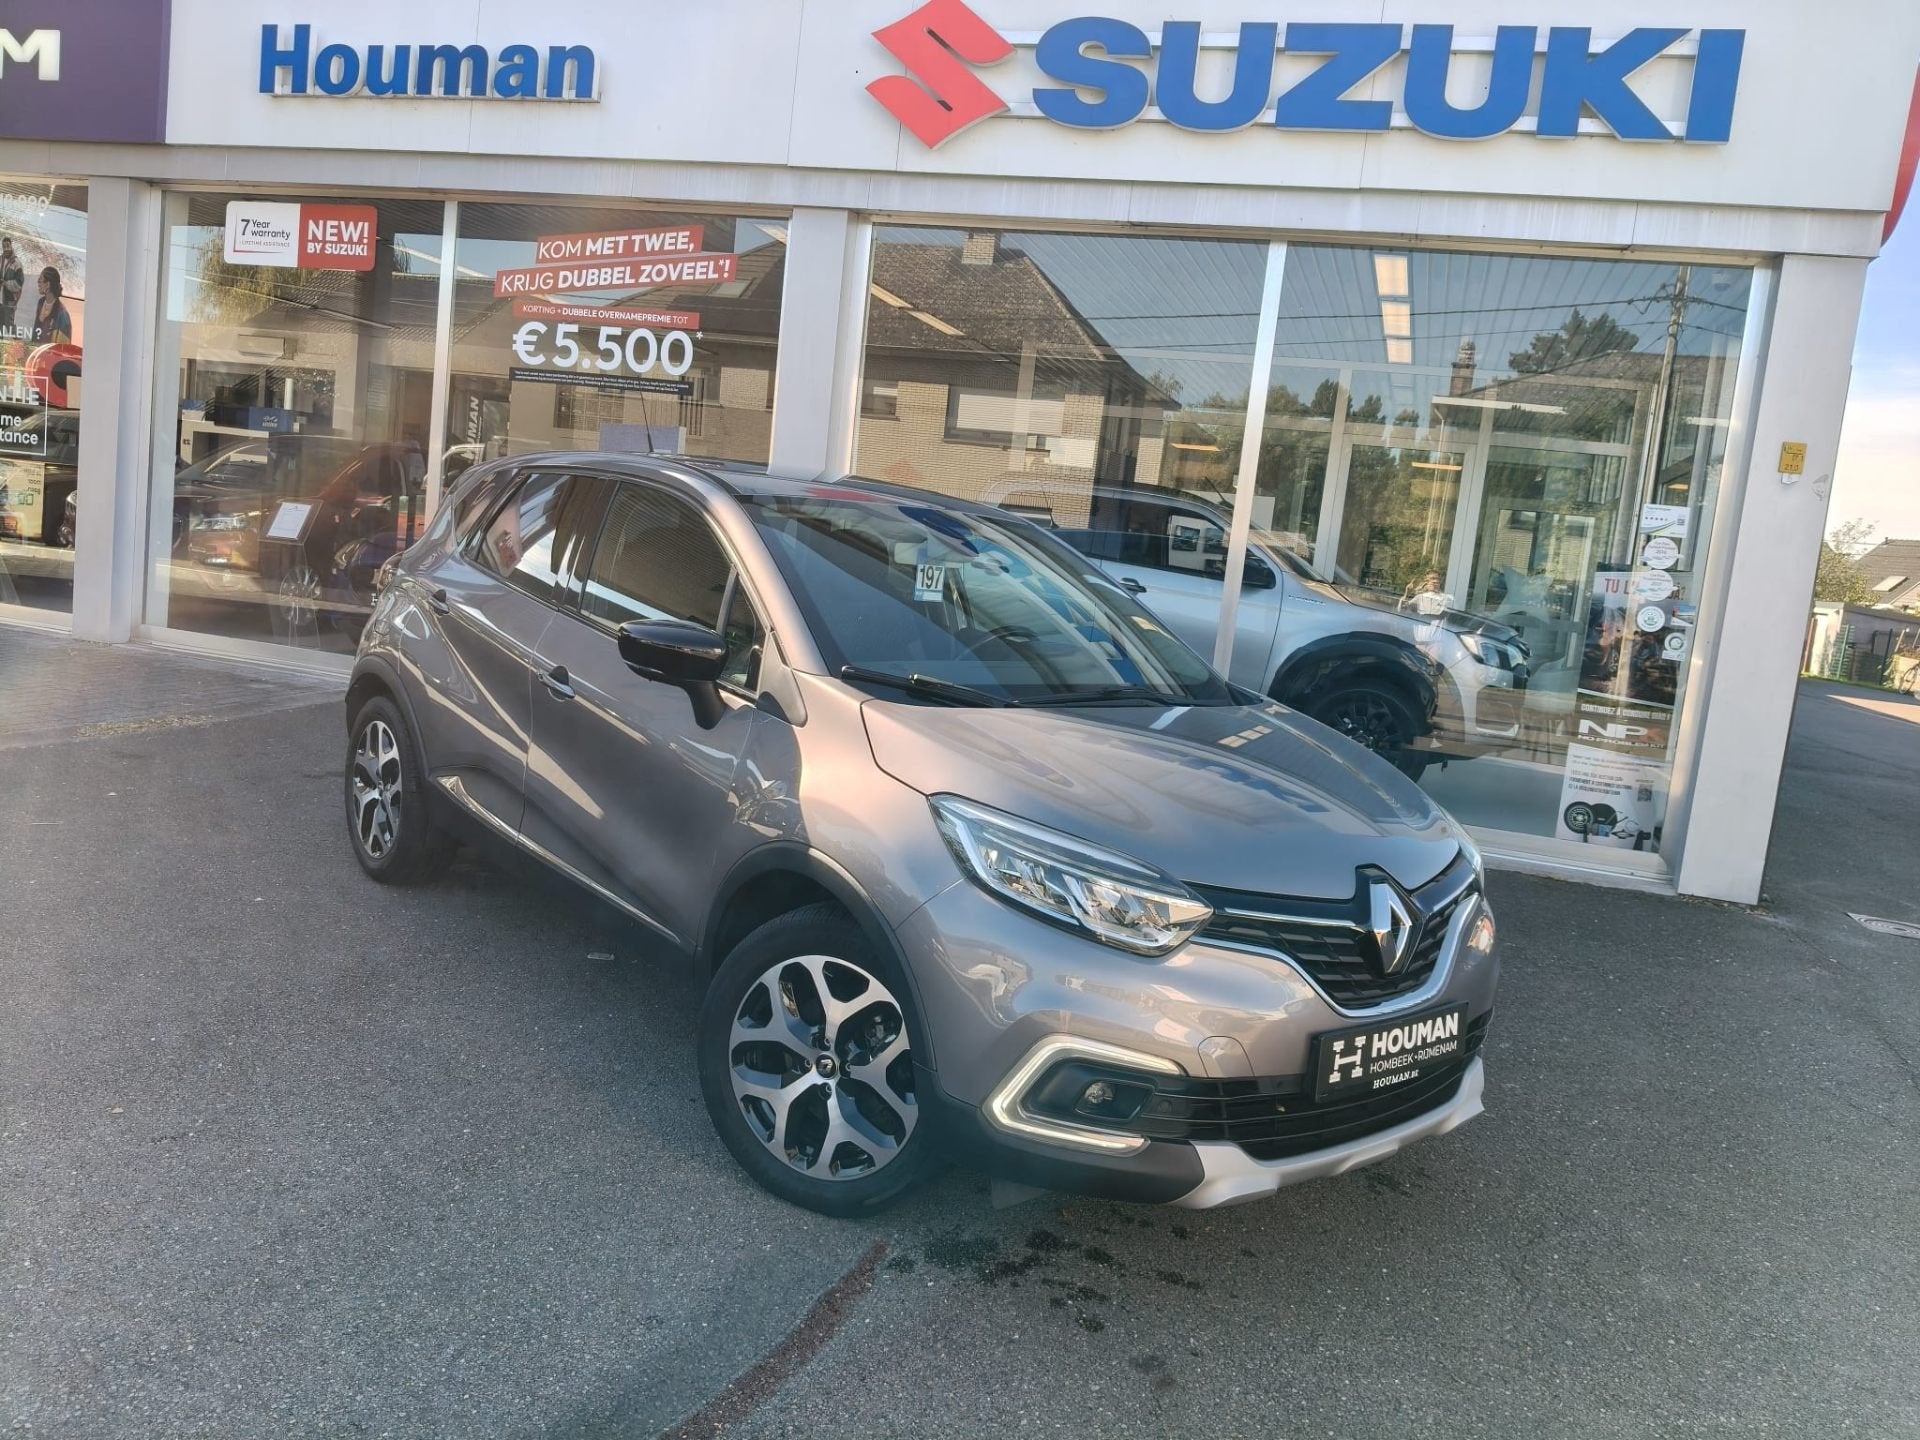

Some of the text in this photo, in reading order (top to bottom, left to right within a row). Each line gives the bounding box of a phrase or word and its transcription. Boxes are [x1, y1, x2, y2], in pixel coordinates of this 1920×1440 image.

[259, 23, 597, 98] Houman
[1033, 17, 1746, 144] SUZUKI
[240, 218, 271, 237] 7 Year
[251, 229, 291, 241] warranty
[307, 219, 370, 244] NEW!
[307, 242, 368, 256] BY SUZUKI
[538, 231, 695, 260] KOM MET TWEE,
[501, 272, 555, 293] KRIJG
[558, 265, 636, 289] DUBBEL
[522, 304, 557, 315] KORTING
[562, 308, 598, 318] DUBBELE
[598, 310, 672, 324] OVERNAMEPREMIE
[672, 315, 689, 325] TOT
[0, 324, 33, 339] LLEN
[919, 565, 943, 589] 197
[1371, 1012, 1459, 1058] HOUMAN
[1370, 1040, 1457, 1074] HOMBEEK RIJMENAM
